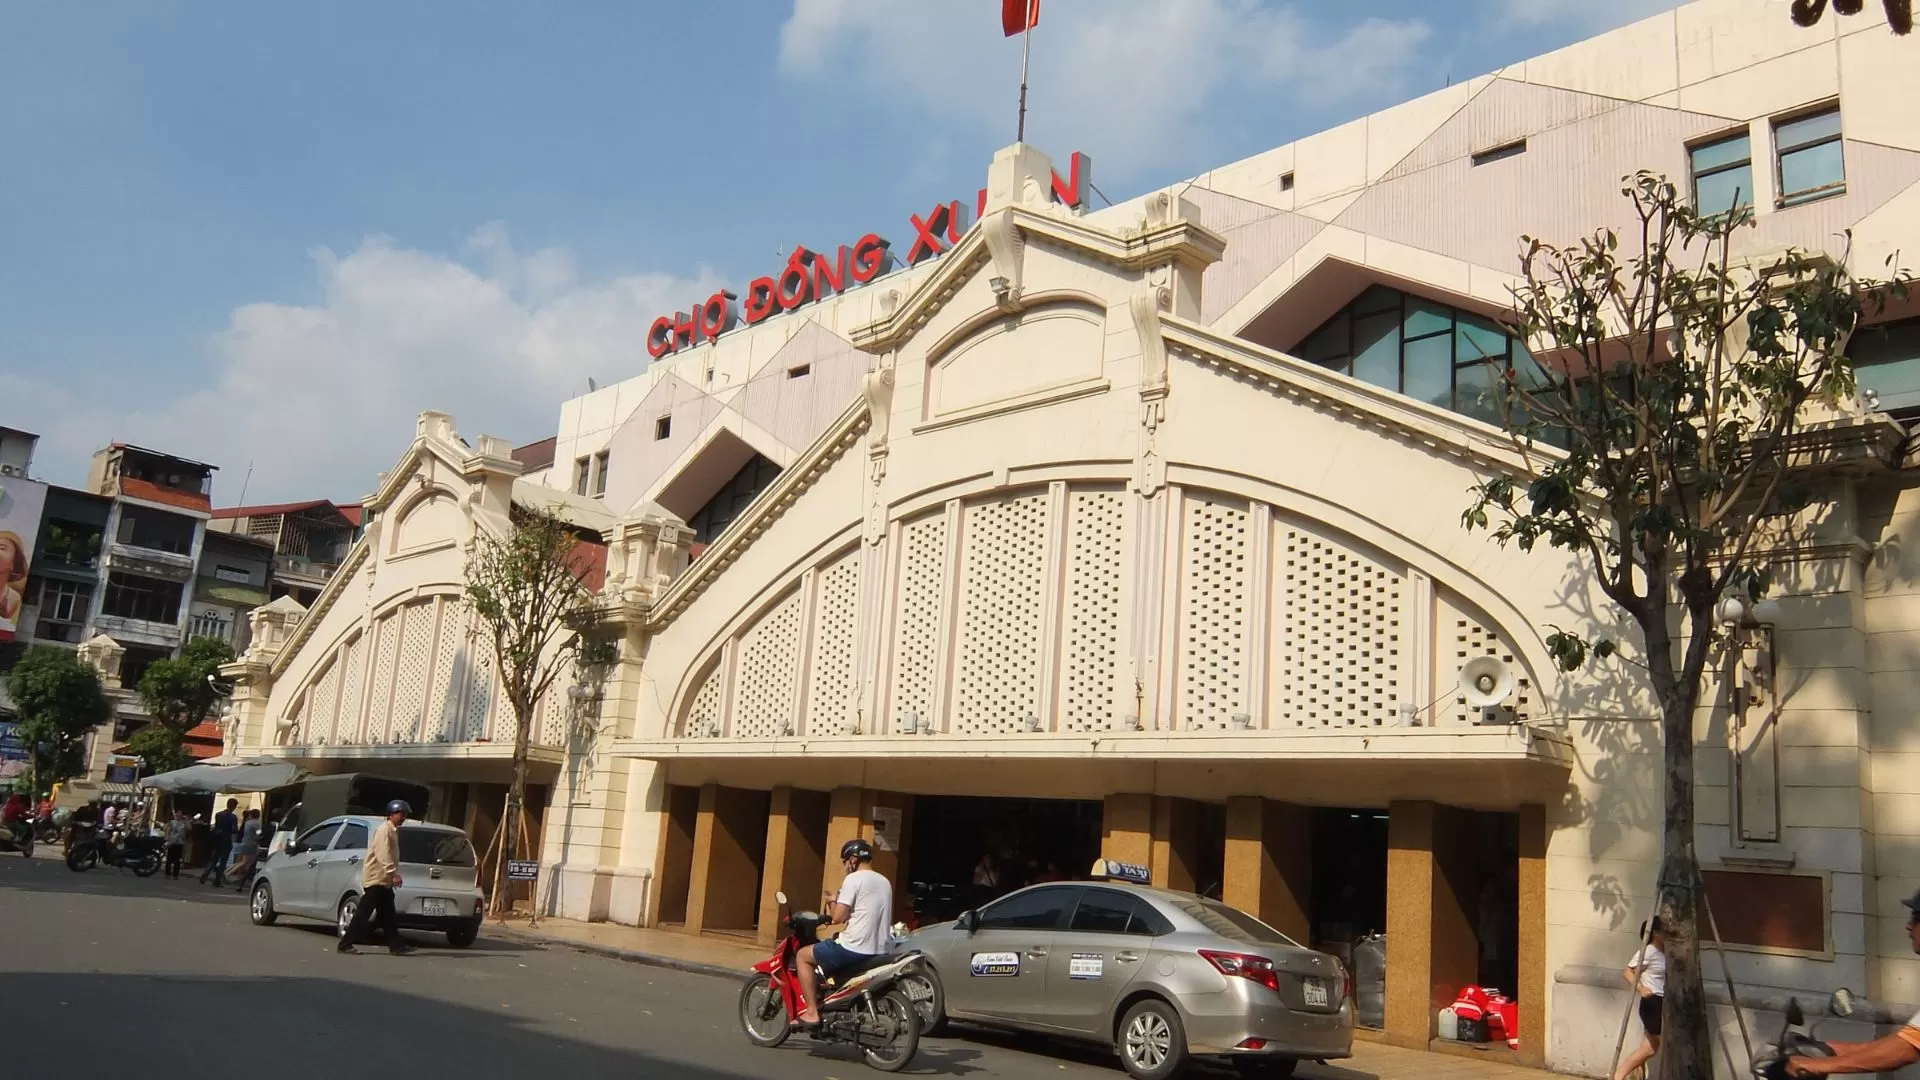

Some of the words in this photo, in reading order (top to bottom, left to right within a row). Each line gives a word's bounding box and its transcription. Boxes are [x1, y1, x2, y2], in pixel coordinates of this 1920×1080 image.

[647, 288, 735, 359] CHỢ
[907, 151, 1084, 265] XUN
[1123, 866, 1148, 879] TAXI
